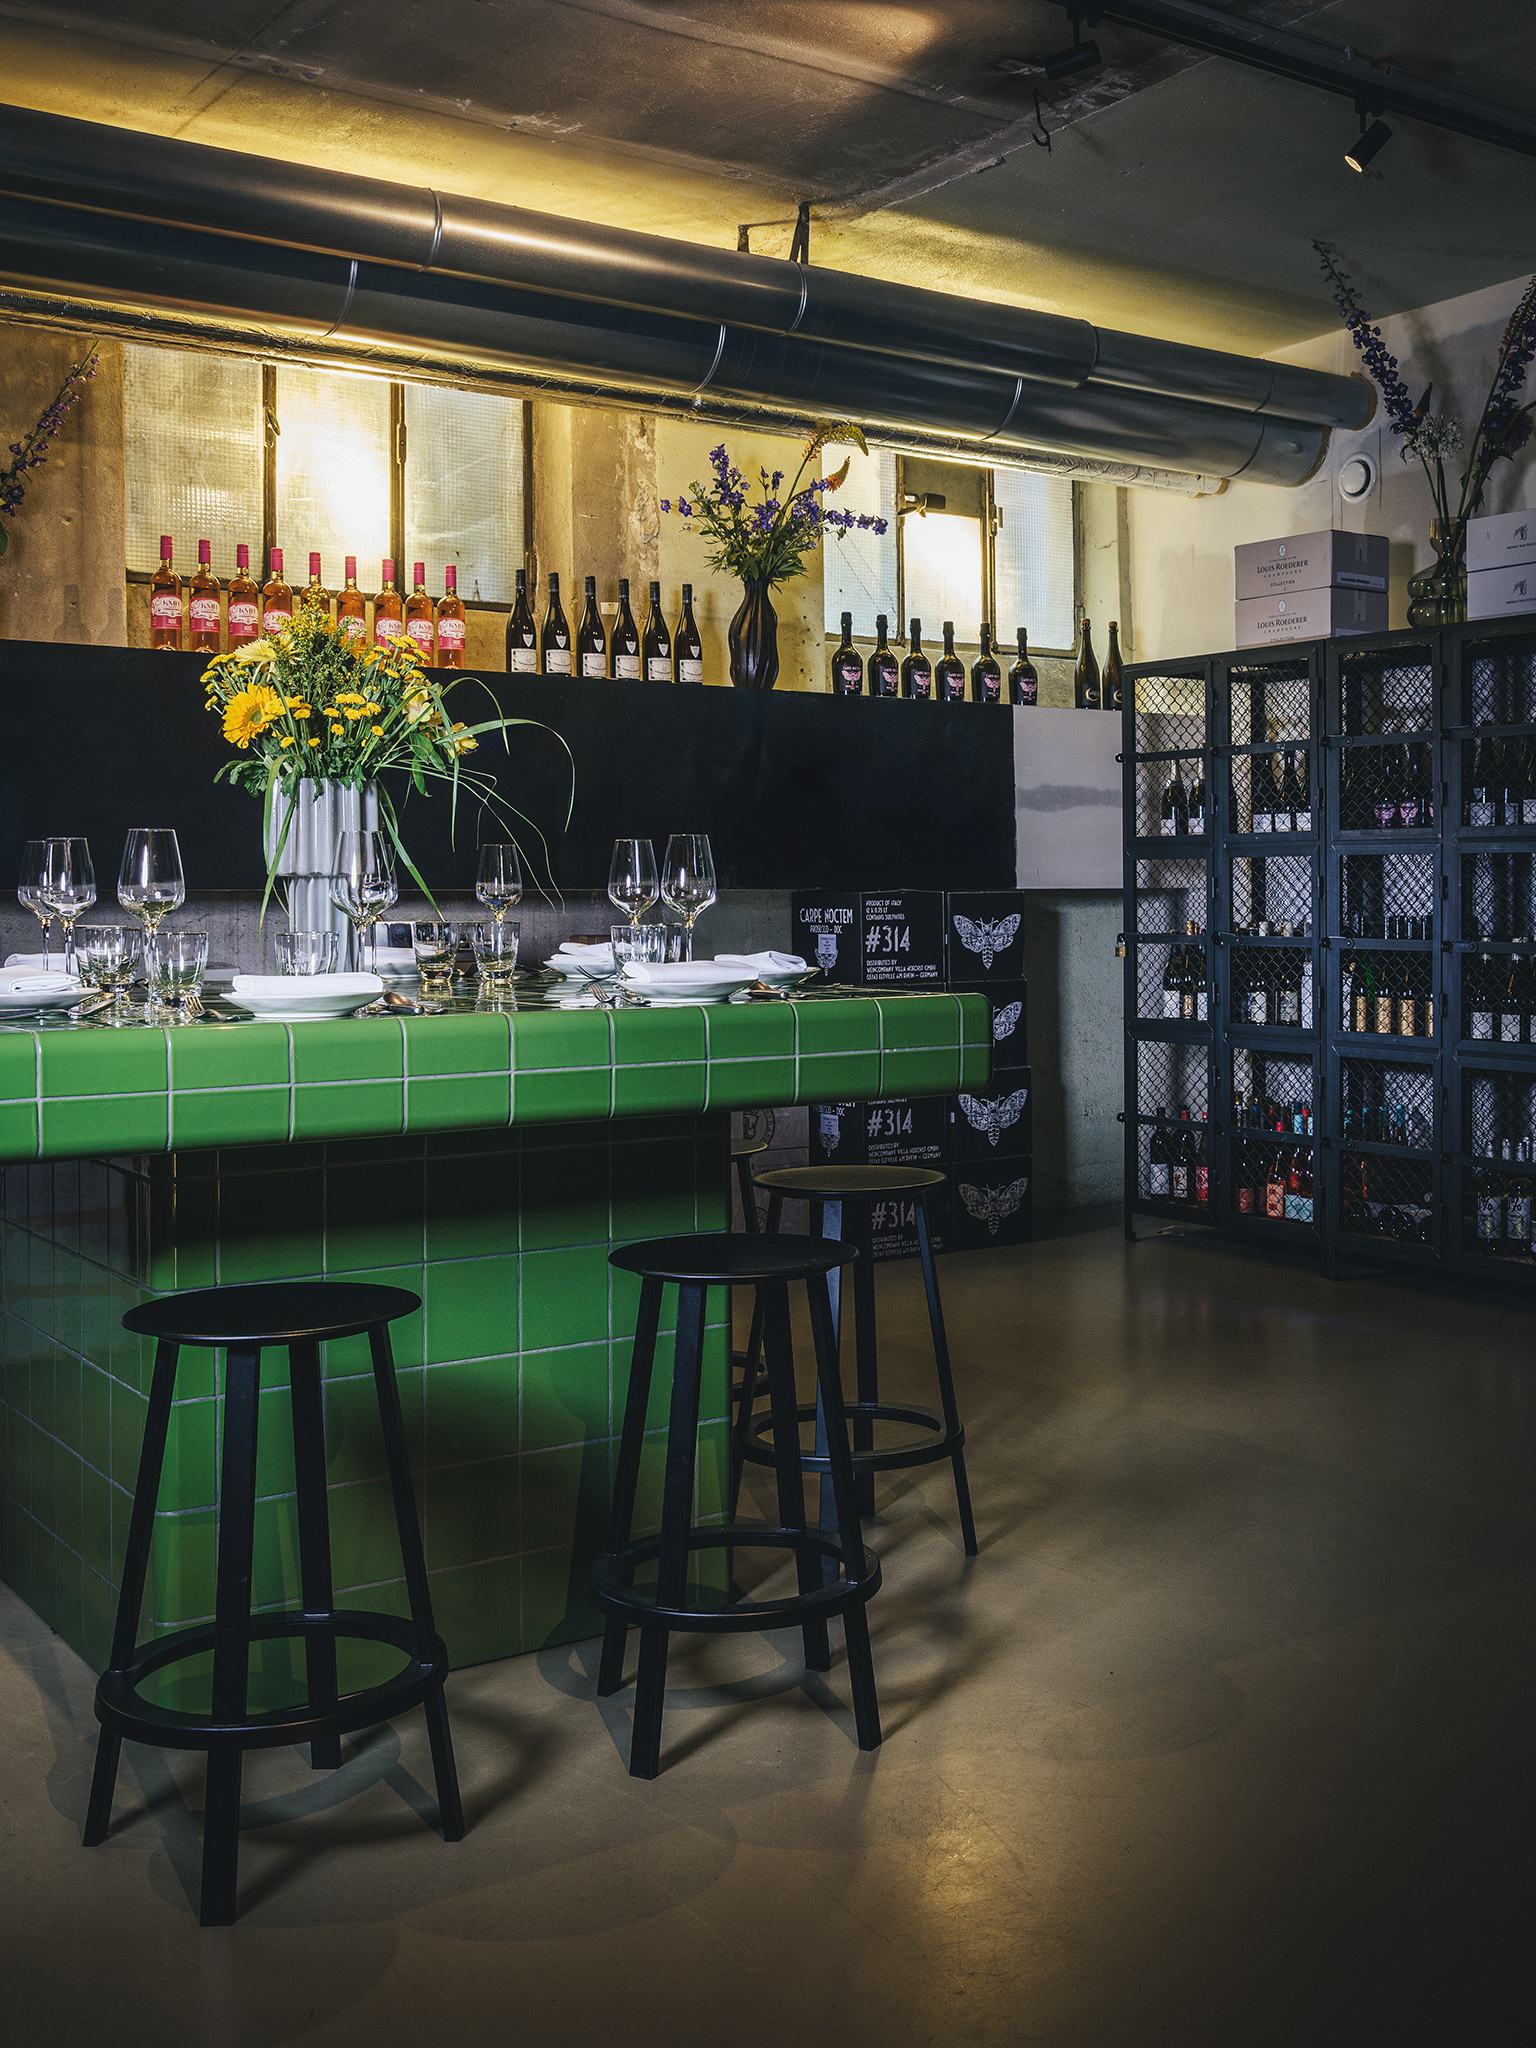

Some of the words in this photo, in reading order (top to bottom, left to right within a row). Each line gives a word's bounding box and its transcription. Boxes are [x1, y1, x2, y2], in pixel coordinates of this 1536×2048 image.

[1275, 560, 1309, 571] ROEDERER
[1275, 616, 1308, 626] ROEDERER
[800, 908, 822, 923] CARPE
[824, 908, 853, 924] NOCTEM
[865, 925, 910, 952] #314
[867, 1108, 913, 1137] #314
[872, 1200, 916, 1230] #314
